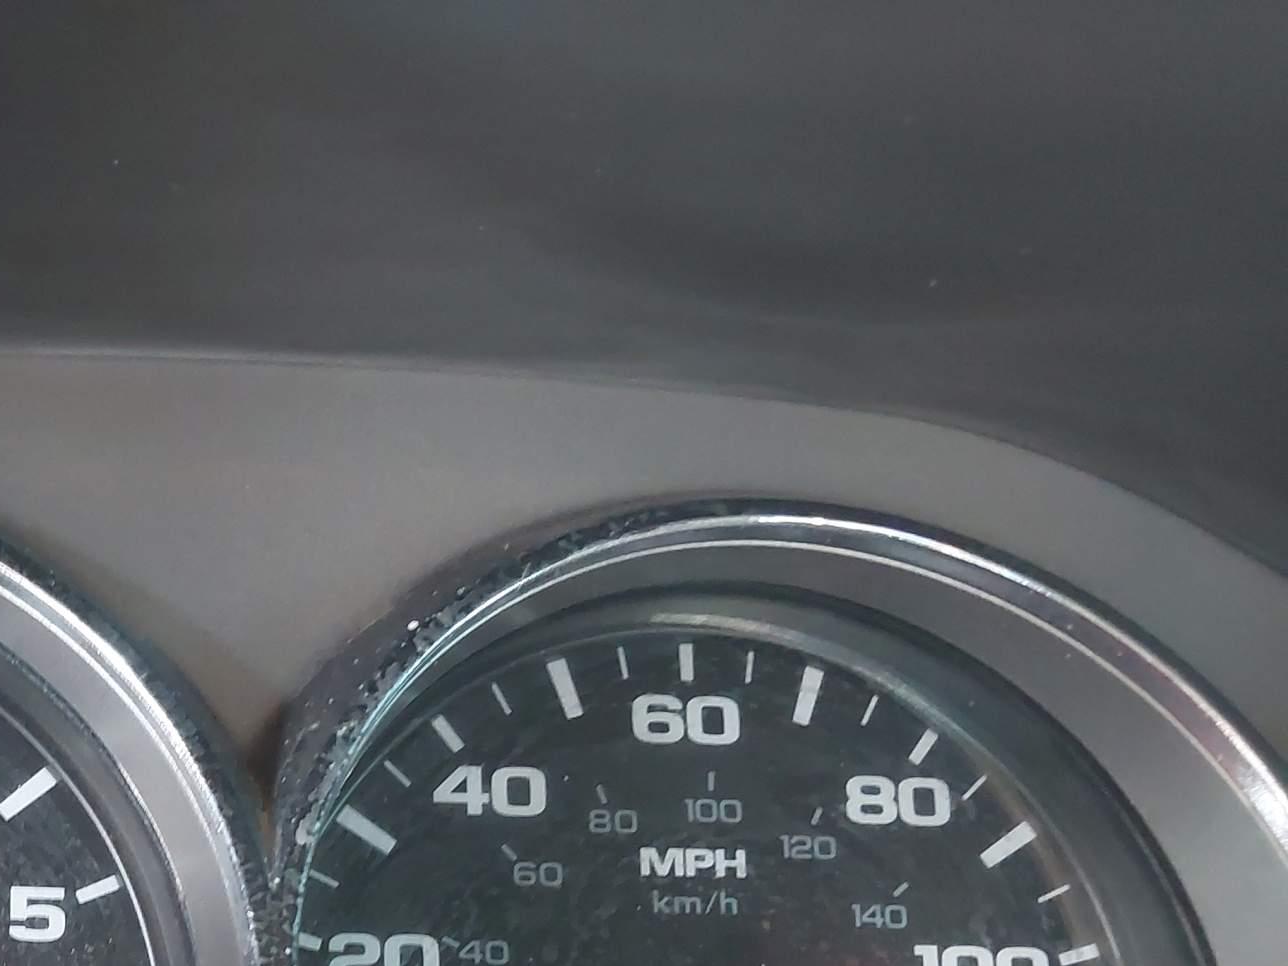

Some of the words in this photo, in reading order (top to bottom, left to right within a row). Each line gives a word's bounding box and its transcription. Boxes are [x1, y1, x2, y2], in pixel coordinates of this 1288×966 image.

[631, 694, 740, 745] 60
[432, 765, 547, 817] 40
[845, 775, 952, 826] 80
[587, 808, 638, 834] 80
[685, 799, 743, 824] 100
[781, 836, 837, 861] 120
[512, 862, 563, 886] 60
[639, 846, 747, 879] MPH
[9, 885, 66, 943] 5
[651, 889, 739, 916] km/h
[852, 903, 908, 929] 140
[457, 939, 510, 966] 40
